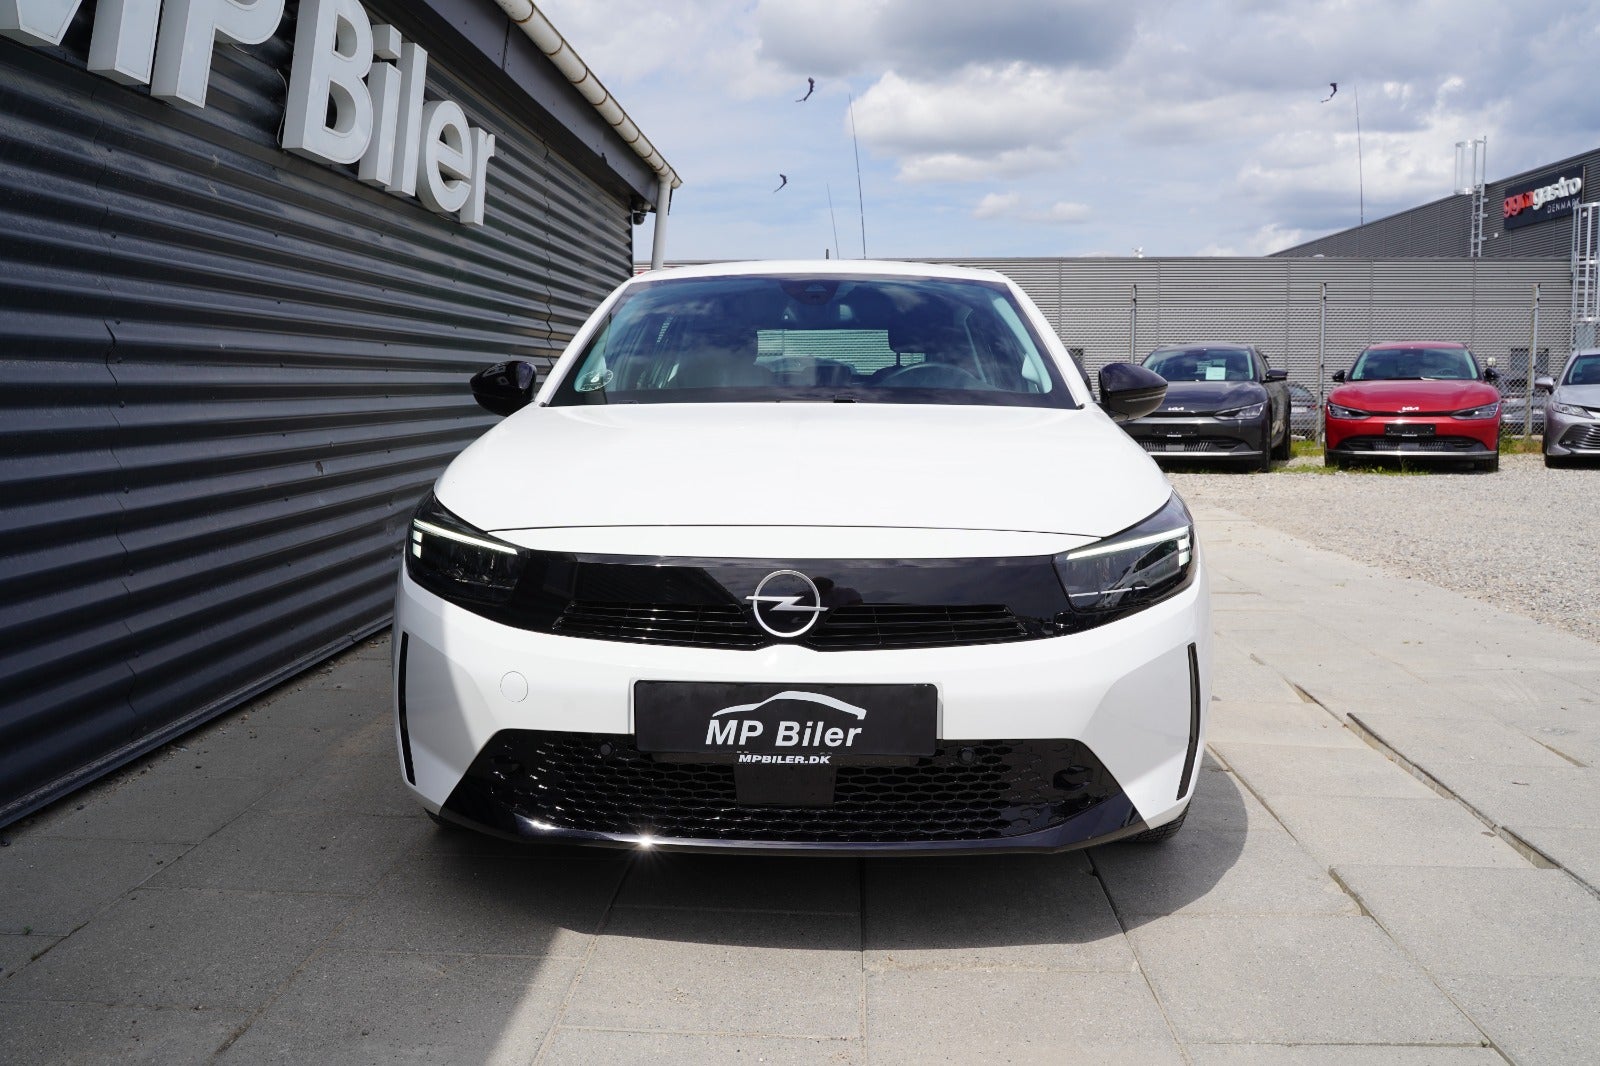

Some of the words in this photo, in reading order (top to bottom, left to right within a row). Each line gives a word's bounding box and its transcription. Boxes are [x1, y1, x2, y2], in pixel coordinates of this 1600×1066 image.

[283, 0, 496, 226] Biler
[705, 719, 764, 746] MP
[775, 720, 862, 747] Biler
[738, 754, 831, 764] MPBILER.DK
